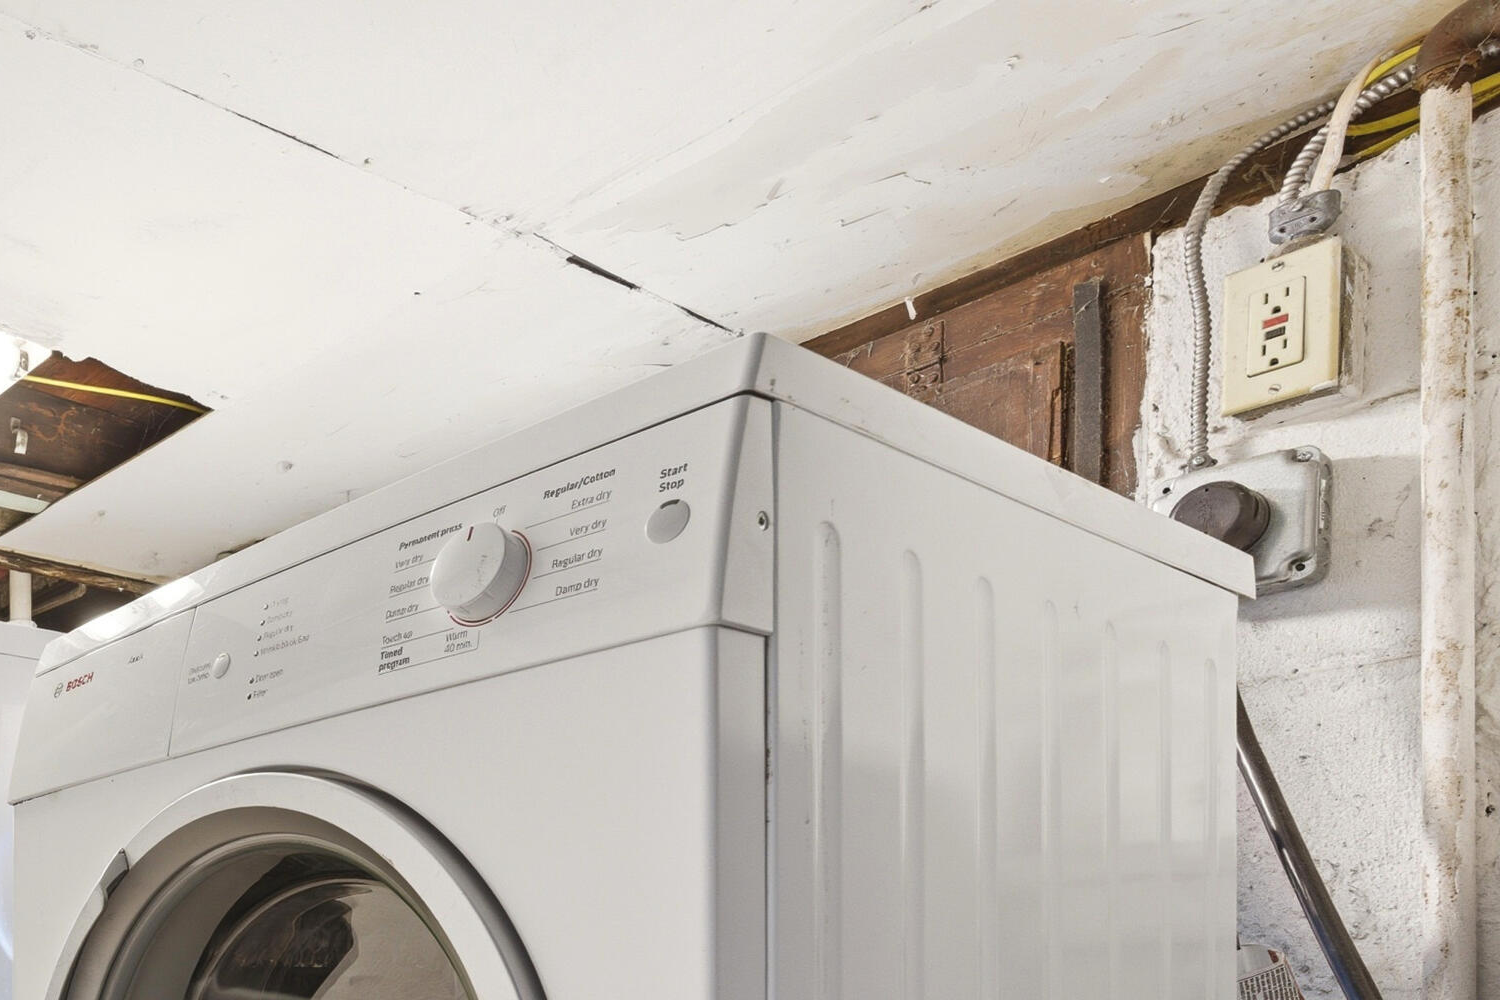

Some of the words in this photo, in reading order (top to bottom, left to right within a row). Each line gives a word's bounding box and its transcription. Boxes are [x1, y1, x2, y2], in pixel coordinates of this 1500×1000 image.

[660, 463, 688, 479] Start
[543, 468, 616, 500] Regular/Cotton
[659, 478, 684, 492] Stop
[571, 495, 594, 509] Extra
[595, 489, 612, 502] dry
[492, 505, 506, 518] Off
[570, 524, 589, 536] Very
[591, 518, 607, 530] dry
[552, 551, 586, 569] Regular
[587, 548, 603, 559] dry
[555, 581, 582, 596] Damp
[583, 577, 600, 589] dry
[380, 647, 403, 660] Timed
[66, 672, 94, 692] BOSCH
